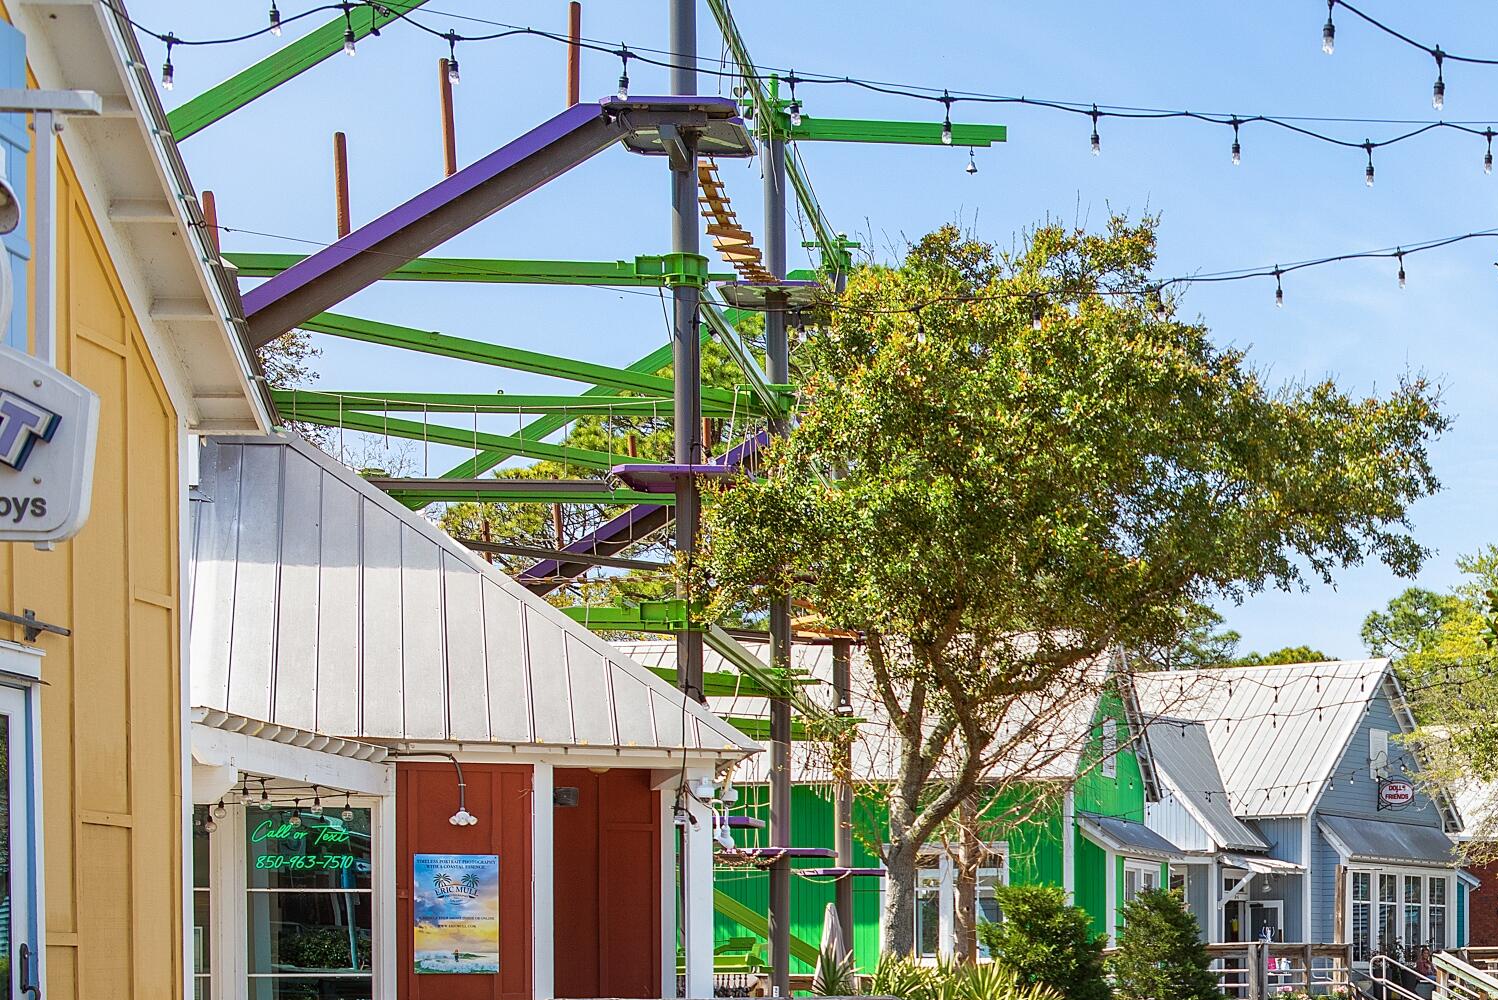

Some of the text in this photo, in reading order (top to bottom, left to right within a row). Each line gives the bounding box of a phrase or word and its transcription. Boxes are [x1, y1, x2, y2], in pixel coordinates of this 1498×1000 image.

[251, 820, 350, 845] Call or Text
[256, 855, 354, 869] 850-963-7510
[434, 886, 478, 896] ERIC MULL
